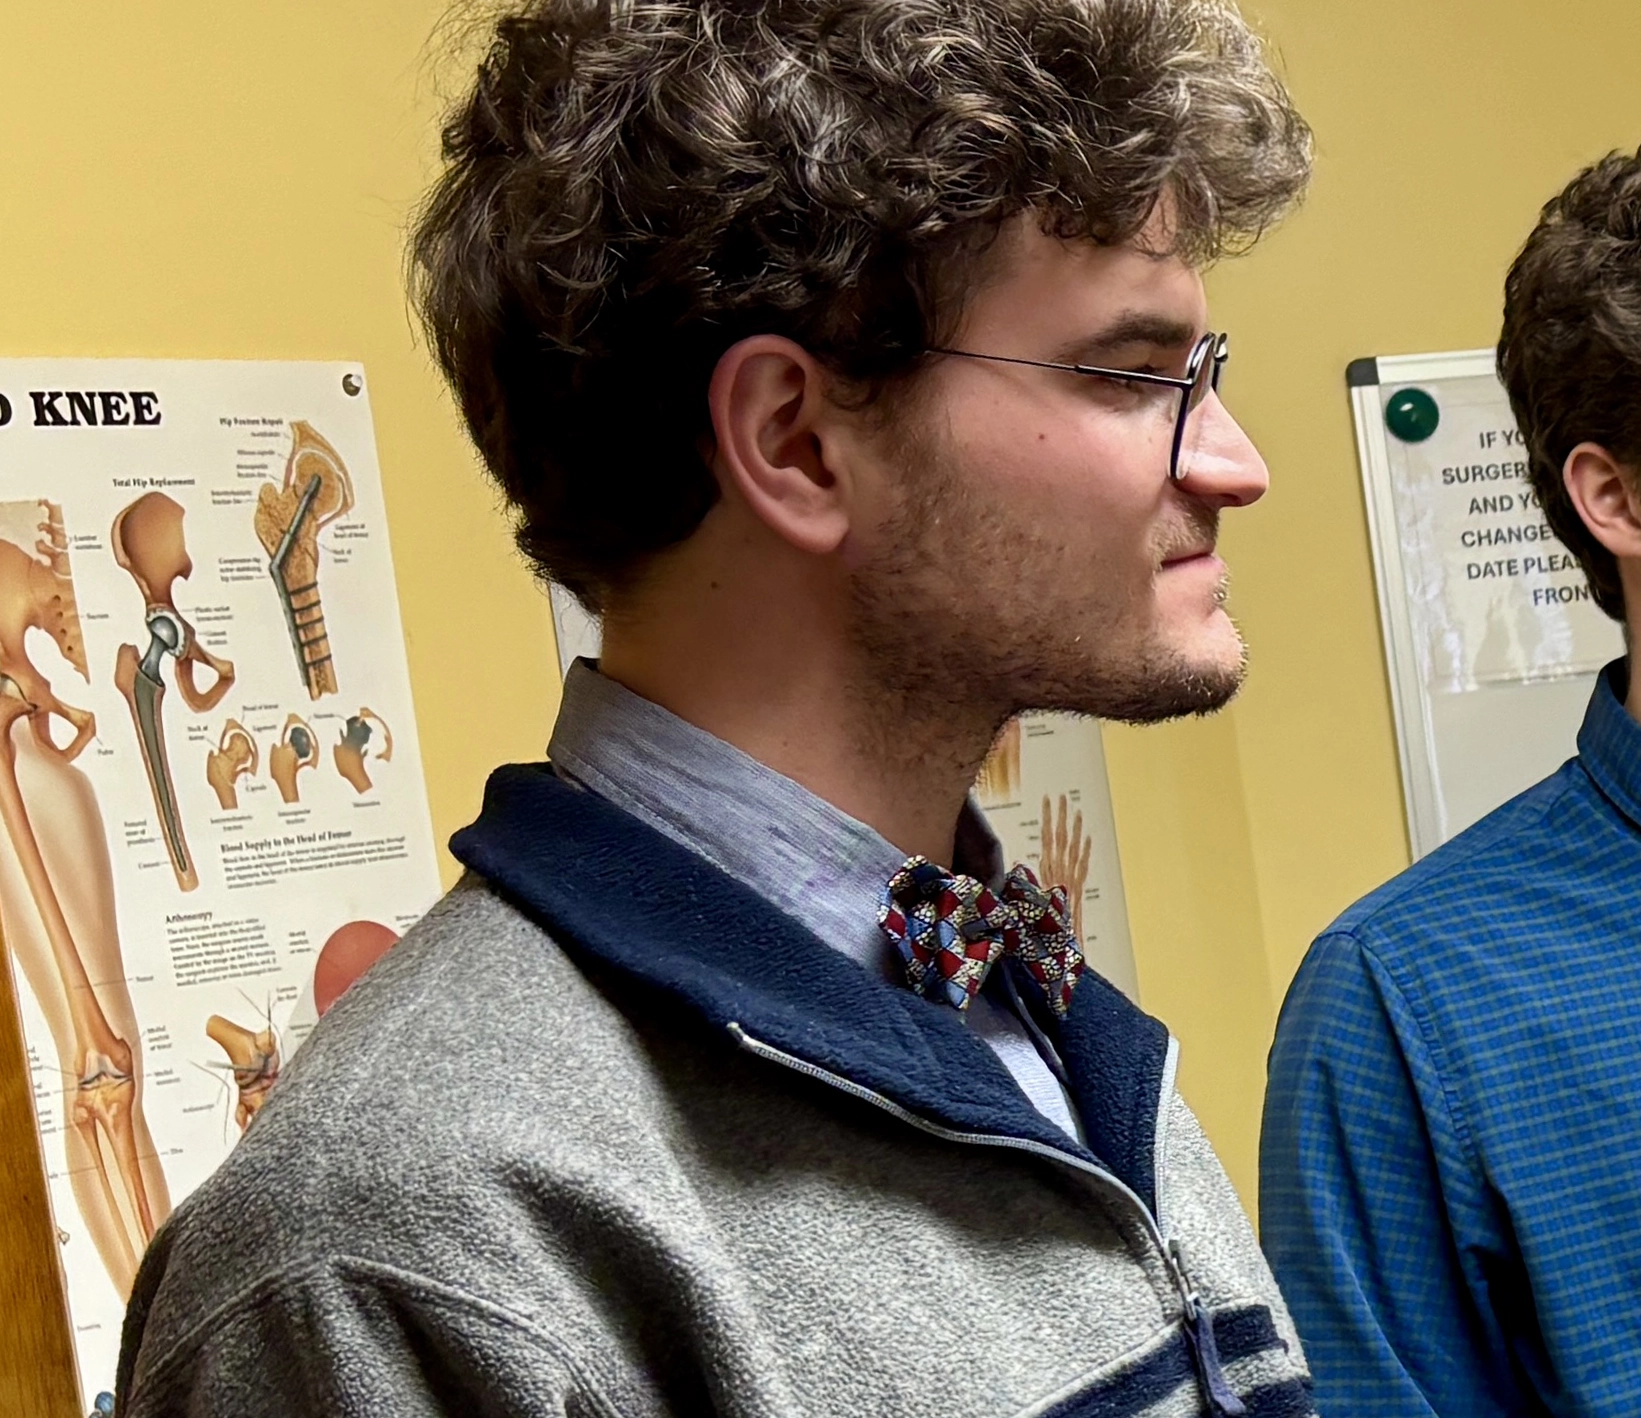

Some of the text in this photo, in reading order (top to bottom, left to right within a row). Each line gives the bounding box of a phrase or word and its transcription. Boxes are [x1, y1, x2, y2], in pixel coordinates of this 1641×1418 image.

[29, 391, 162, 426] KNEE
[1479, 428, 1527, 449] IF YO
[1442, 461, 1529, 485] SURGER
[1469, 494, 1514, 515] AND
[1467, 558, 1519, 580] DATE
[1533, 584, 1589, 606] FRON
